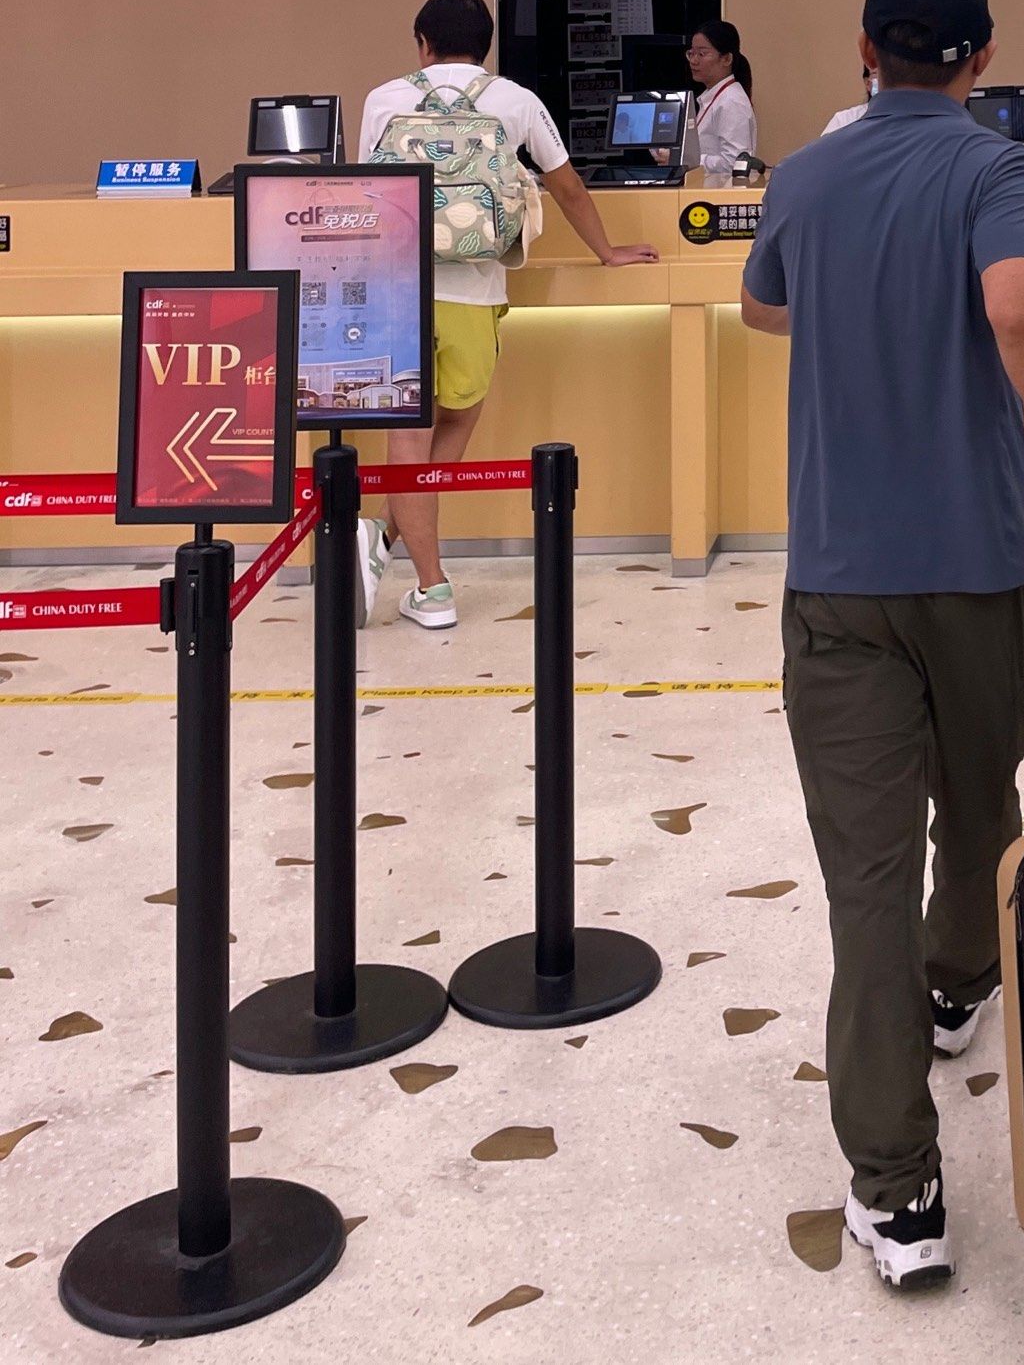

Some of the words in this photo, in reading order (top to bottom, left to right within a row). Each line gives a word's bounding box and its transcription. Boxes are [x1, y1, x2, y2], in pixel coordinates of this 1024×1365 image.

[540, 110, 560, 147] DESCENTE
[115, 162, 181, 177] 暂停服务
[285, 206, 323, 226] cdf
[323, 213, 380, 229] 免税店
[146, 300, 163, 309] cdf
[142, 343, 241, 385] VIP
[244, 366, 276, 385] 柜台
[363, 476, 382, 484] FREE
[416, 470, 442, 484] cdf
[457, 473, 484, 481] CHINA
[485, 472, 507, 480] DUTY
[508, 470, 527, 479] FREE
[4, 492, 32, 507] cdf
[47, 497, 74, 505] CHINA
[75, 496, 97, 504] DUTY
[32, 605, 66, 616] CHINA
[68, 604, 96, 614] DUTY
[98, 602, 123, 613] FREE
